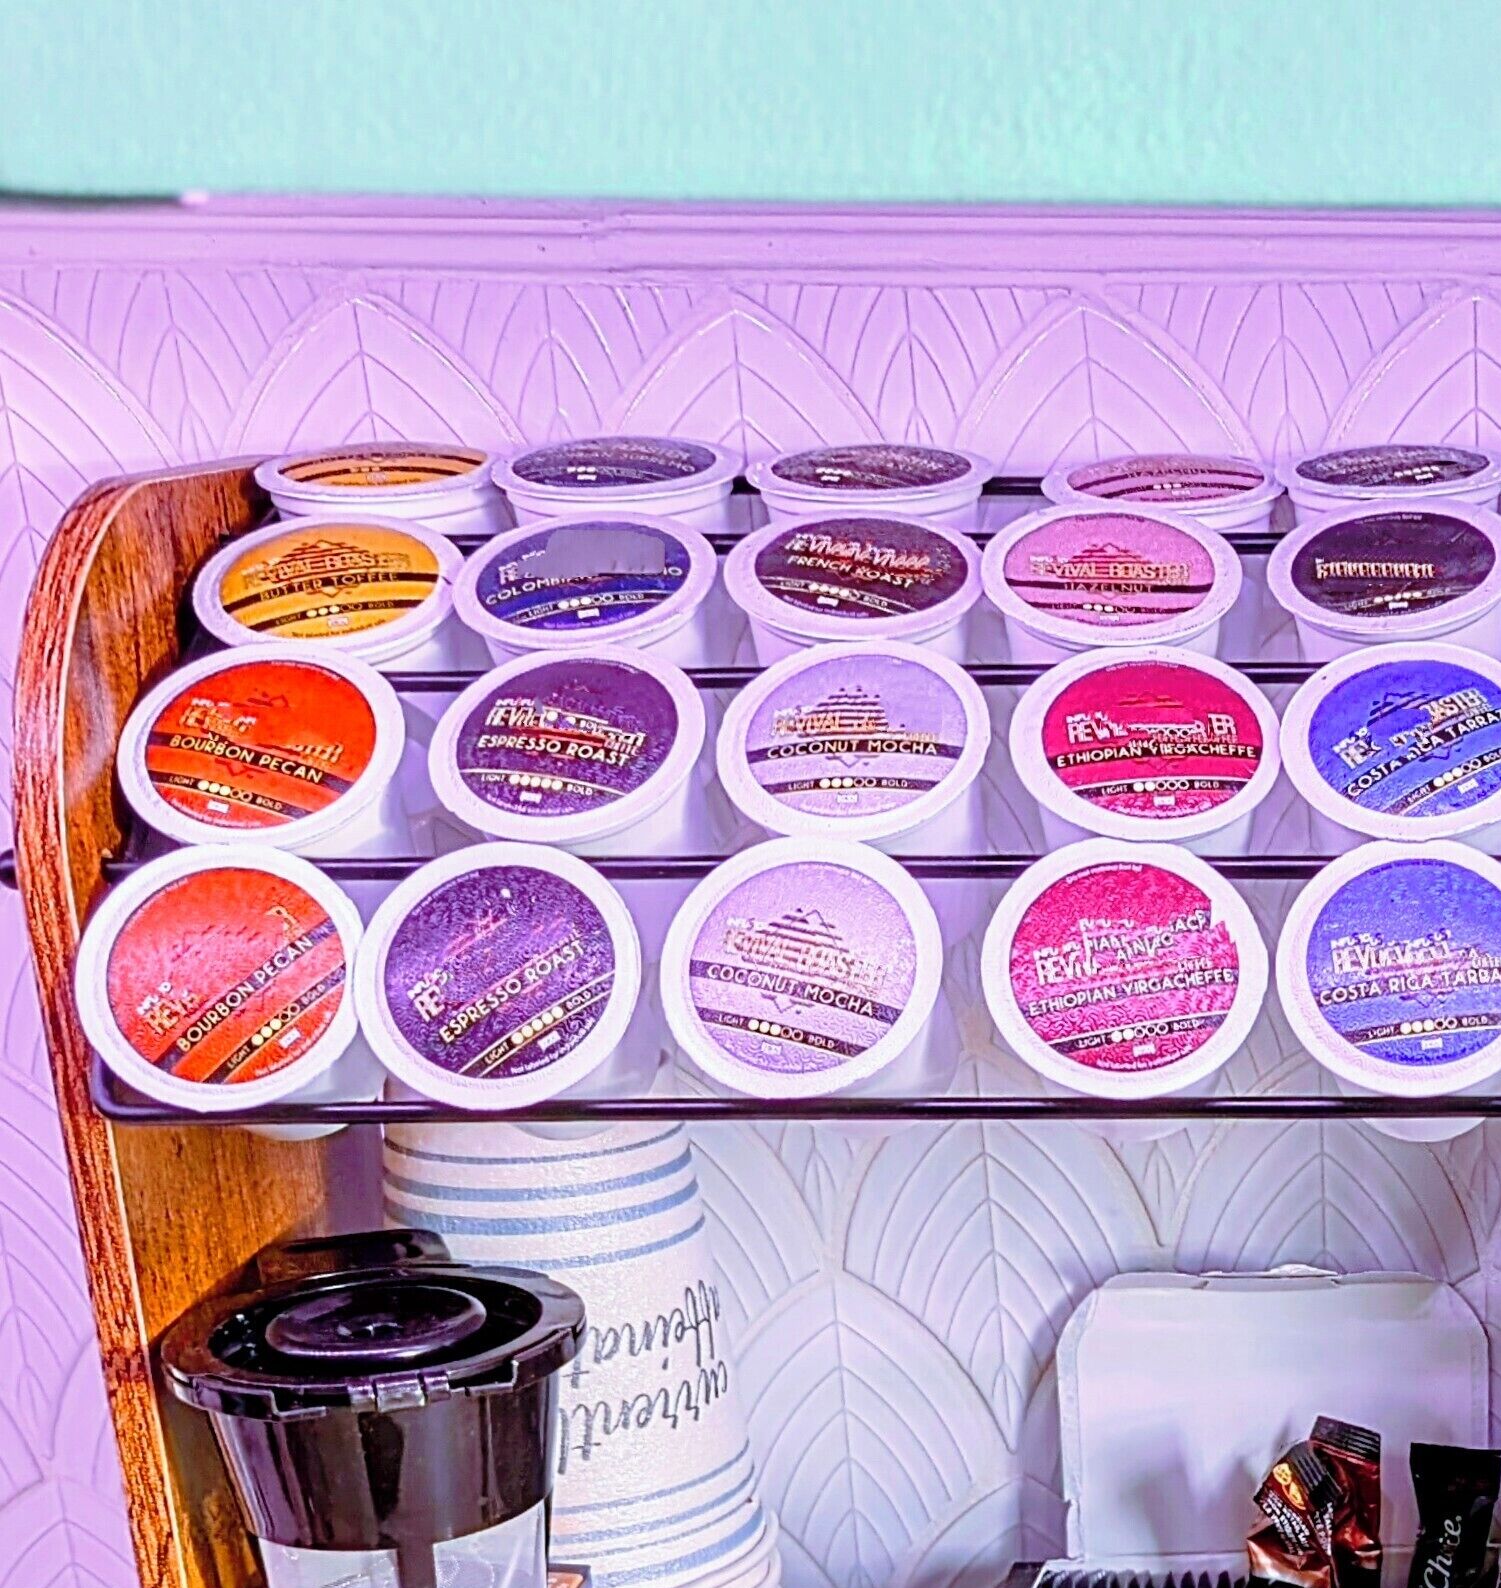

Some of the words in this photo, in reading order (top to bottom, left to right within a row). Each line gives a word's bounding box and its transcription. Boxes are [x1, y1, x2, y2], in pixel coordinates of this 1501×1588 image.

[786, 555, 852, 572] FRENCH
[259, 579, 323, 601] BUTTER
[332, 572, 399, 588] TOFFEE
[169, 734, 254, 764] BOURBON
[258, 754, 323, 784] PECAN
[477, 735, 562, 752] ESPRESSO
[566, 744, 630, 767] ROAST
[767, 741, 860, 759] COCONUT
[867, 741, 938, 756] MOCHA
[1056, 745, 1143, 768] ETHIOPIAN
[1347, 758, 1402, 797] COSTA
[176, 981, 256, 1053] BOURBON
[254, 937, 314, 986] PECAN
[439, 977, 523, 1044] ESPRESSO
[523, 939, 587, 986] ROAST
[707, 964, 798, 996] COCONUT
[803, 984, 874, 1017] MOCHA
[1029, 985, 1117, 1017] ETHIOPIAN
[1122, 969, 1235, 999] YIRGACHEFFE
[1319, 984, 1382, 1006] COSTA
[1389, 976, 1433, 994] RICA
[227, 1046, 251, 1070] LIGHT
[484, 1042, 510, 1065] LIGHT
[557, 1360, 728, 1475] currentl
